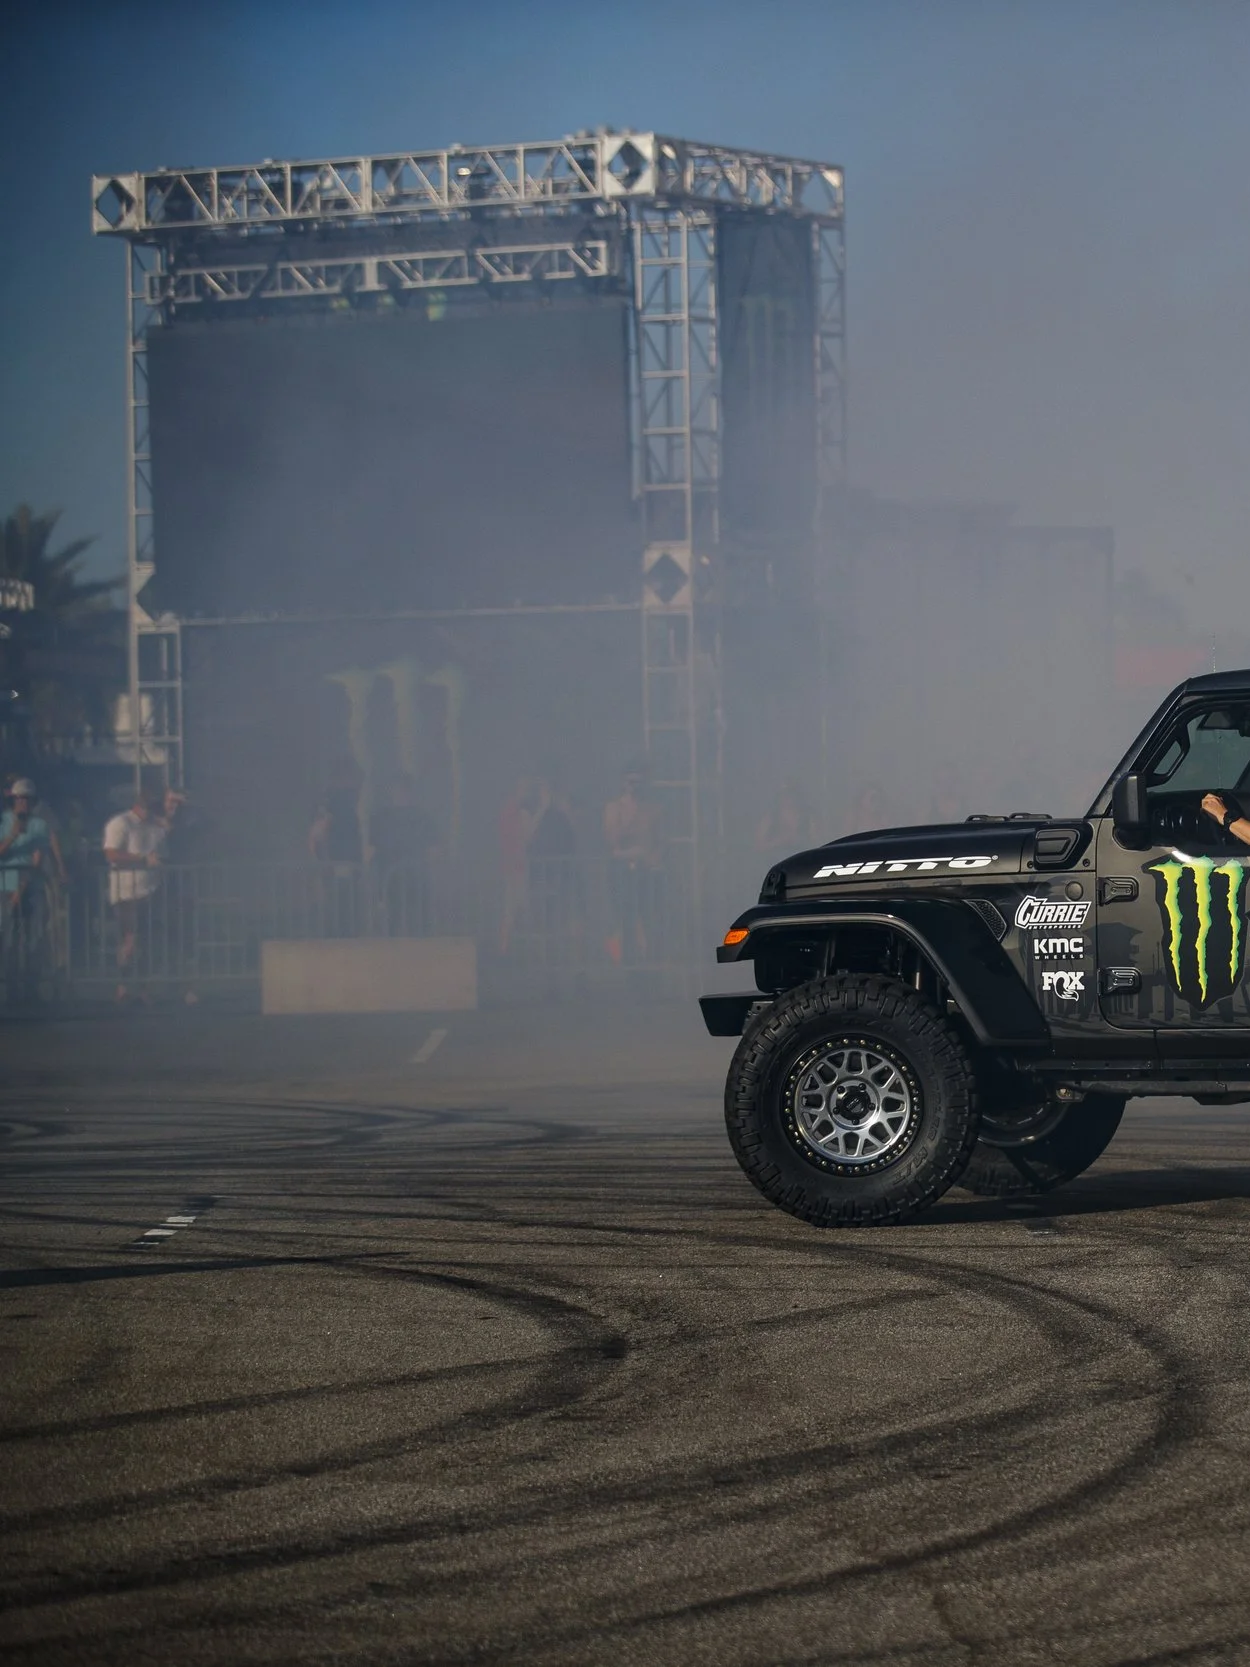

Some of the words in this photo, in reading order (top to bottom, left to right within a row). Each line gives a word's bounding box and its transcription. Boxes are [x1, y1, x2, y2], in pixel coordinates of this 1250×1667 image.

[1017, 898, 1088, 926] CURRIE
[1033, 937, 1084, 954] KMC
[1041, 970, 1085, 1001] FOX
